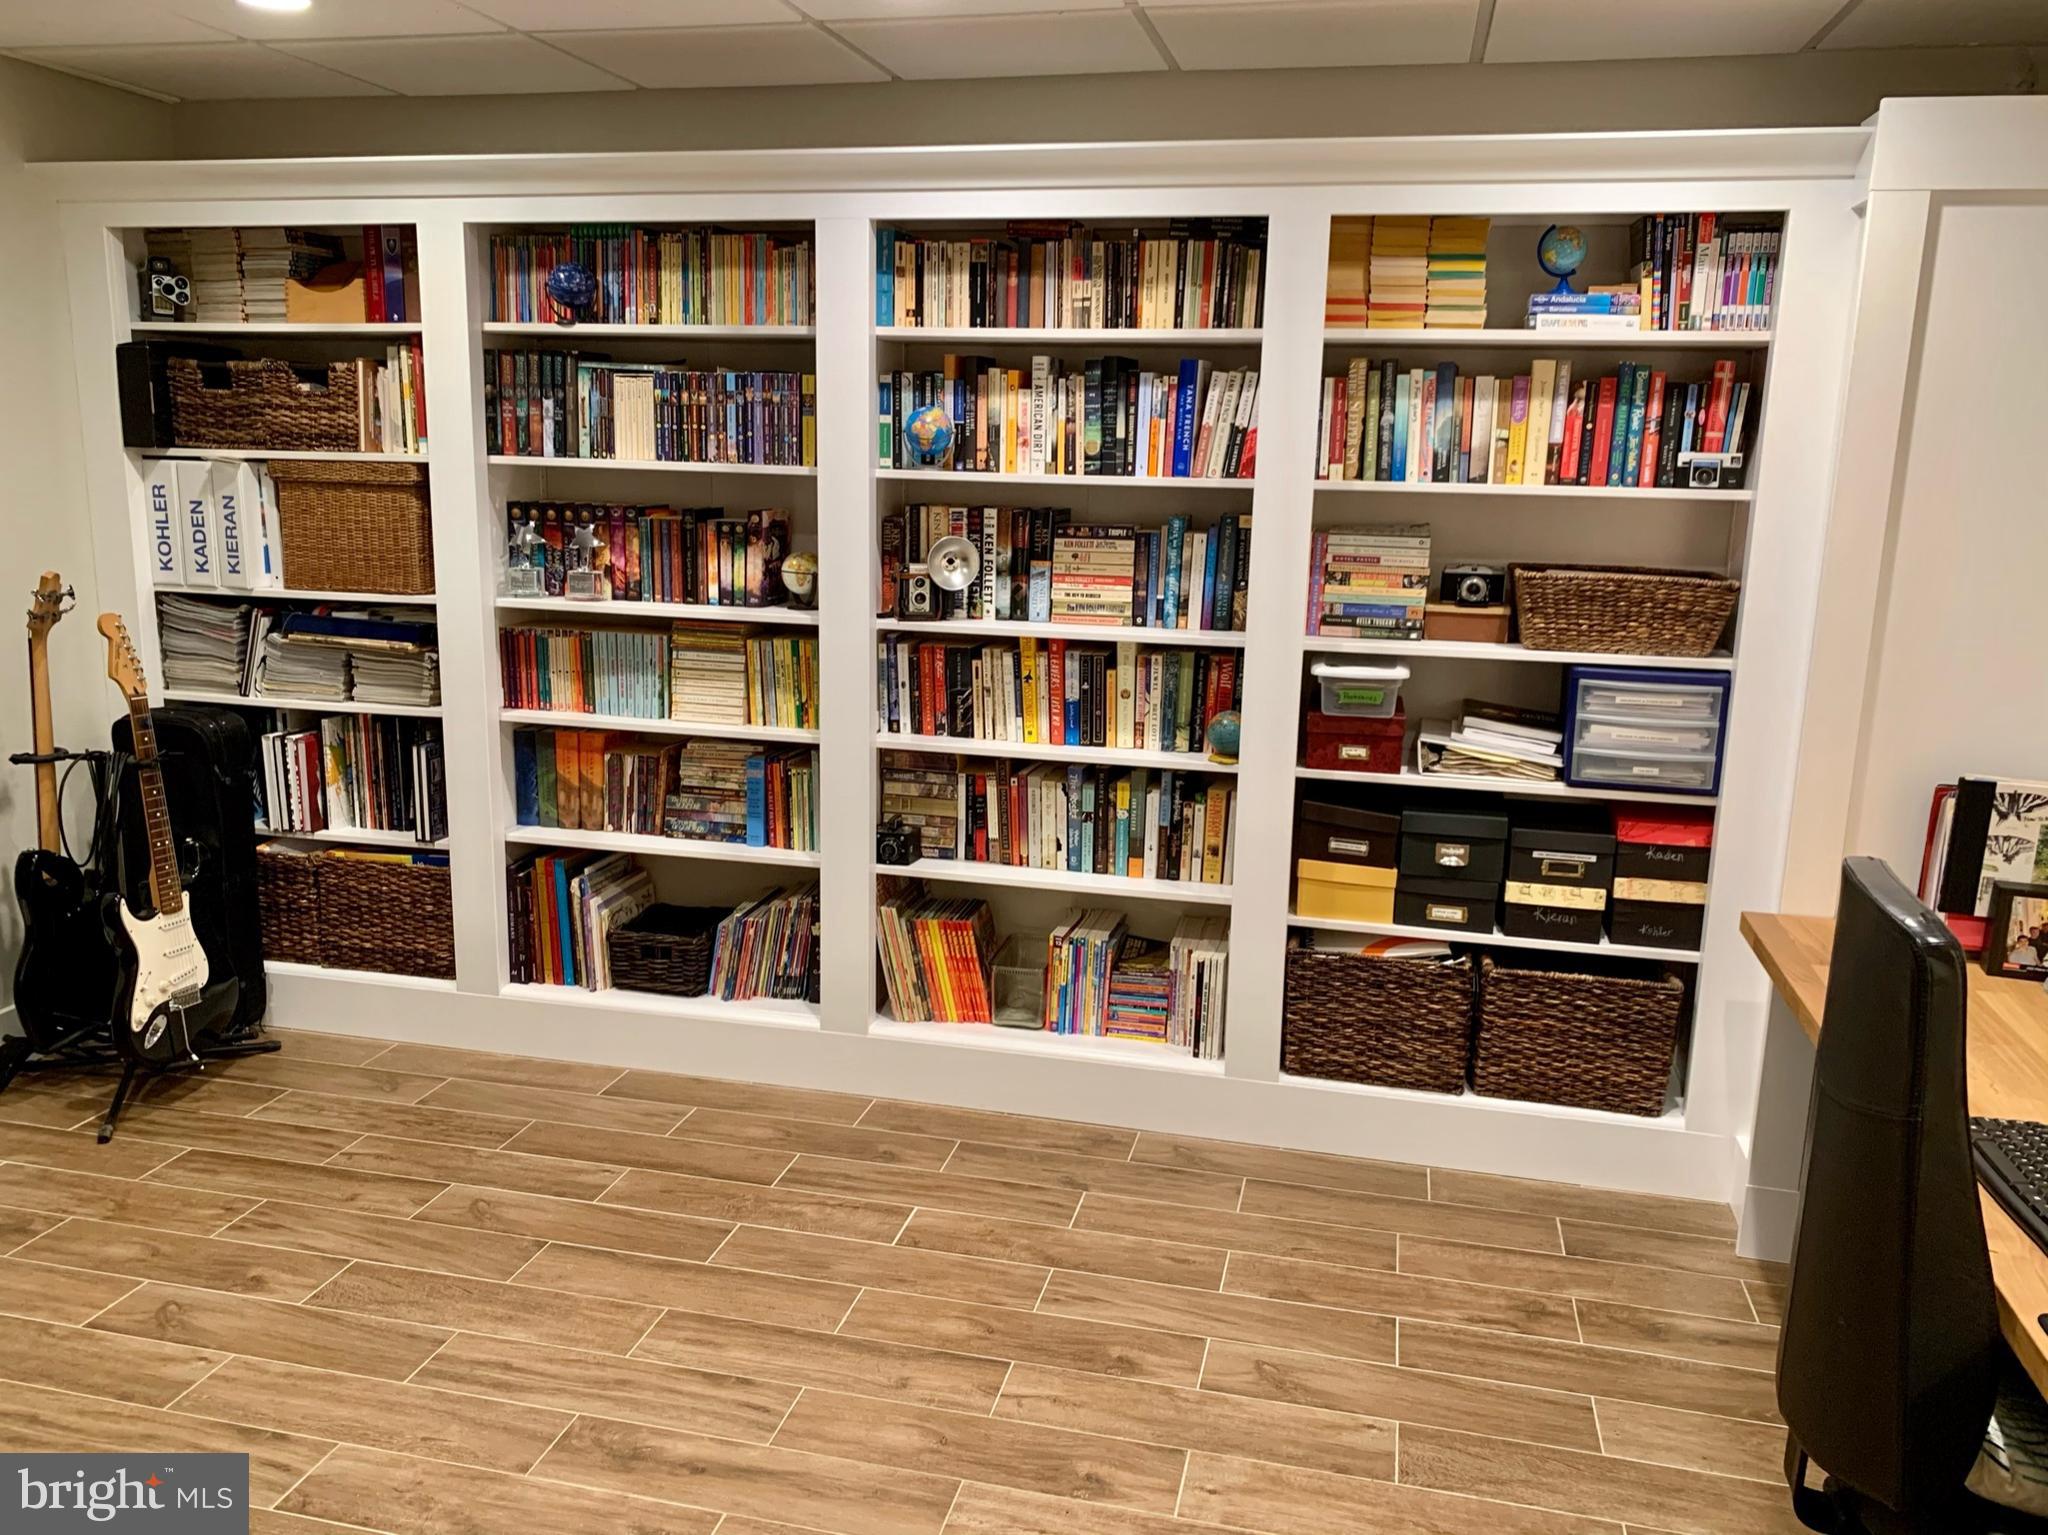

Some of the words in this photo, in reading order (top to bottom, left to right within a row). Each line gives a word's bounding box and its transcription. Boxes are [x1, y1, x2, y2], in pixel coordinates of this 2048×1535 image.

[1550, 295, 1587, 304] Andalucia
[1212, 375, 1220, 392] TANA
[1228, 375, 1238, 392] TANA
[1246, 375, 1255, 393] TANA
[1348, 360, 1359, 396] SAFIRE
[1185, 383, 1194, 411] TANA
[1426, 379, 1434, 404] HOME
[1033, 383, 1044, 431] AMERICAN
[1206, 394, 1216, 420] FRENCH
[1222, 394, 1234, 423] FRENCH
[1240, 395, 1250, 421] FRENCH
[1182, 413, 1192, 451] FRENCH
[1347, 401, 1362, 446] SLEEPER
[1616, 404, 1627, 441] MIRACLES
[1033, 433, 1043, 454] DIRT
[1346, 447, 1357, 465] SPY
[1229, 445, 1240, 473] LIKENESS
[152, 484, 174, 571] KOHLER
[932, 511, 944, 530] KEN
[1108, 528, 1127, 536] TRIPLE
[189, 500, 210, 574] KADEN
[222, 495, 241, 574] KIERAN
[892, 528, 900, 545] KEN
[984, 533, 993, 554] KEN
[1034, 519, 1042, 552] FOLLETT
[1063, 540, 1074, 548] KEN
[1075, 540, 1094, 548] FOLLETT
[983, 559, 994, 605] FOLLETT
[1221, 584, 1230, 617] KRISTIN
[1356, 616, 1371, 624] BELLA
[1373, 617, 1396, 626] TUSCANY
[1051, 654, 1061, 688] LEAVERS
[1152, 667, 1160, 691] JEWEL
[1220, 661, 1233, 689] Wolf
[1051, 696, 1061, 714] LISA
[1151, 723, 1159, 742] LOTT
[1070, 774, 1079, 790] The
[999, 789, 1009, 824] MADELINE
[1000, 825, 1009, 849] MILLER
[1645, 846, 1684, 863] Kaden
[1639, 922, 1674, 938] Kohler
